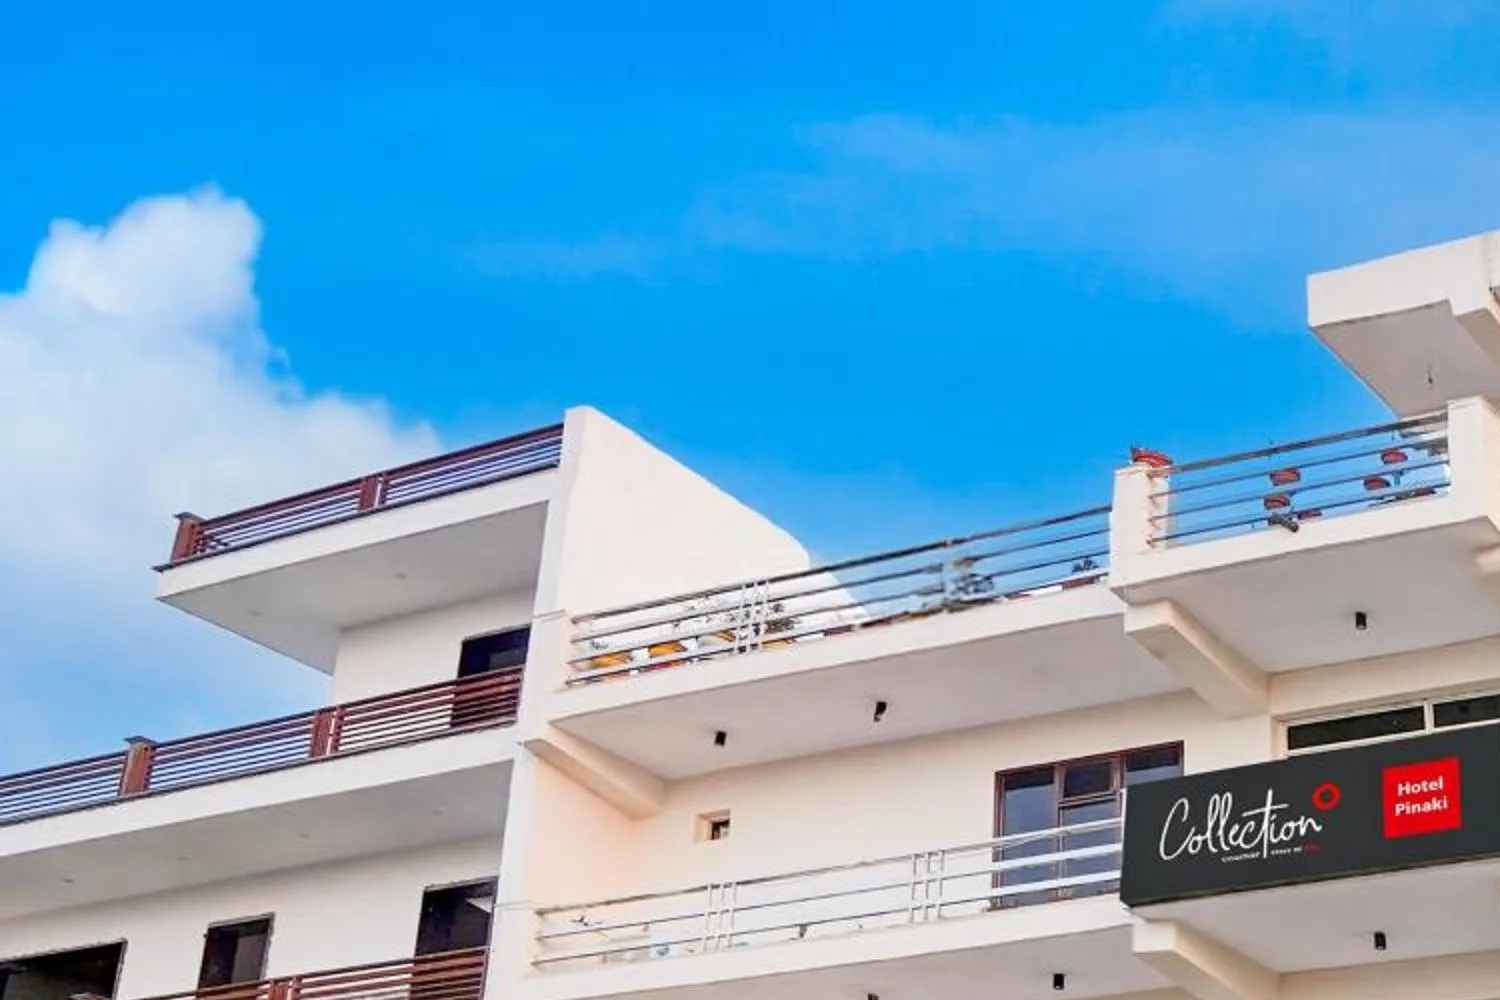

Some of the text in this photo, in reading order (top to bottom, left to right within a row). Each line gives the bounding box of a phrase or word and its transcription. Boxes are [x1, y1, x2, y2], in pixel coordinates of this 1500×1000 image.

[1397, 775, 1444, 797] Hotel
[1395, 795, 1449, 817] Pinaki
[1159, 788, 1323, 861] Collection
